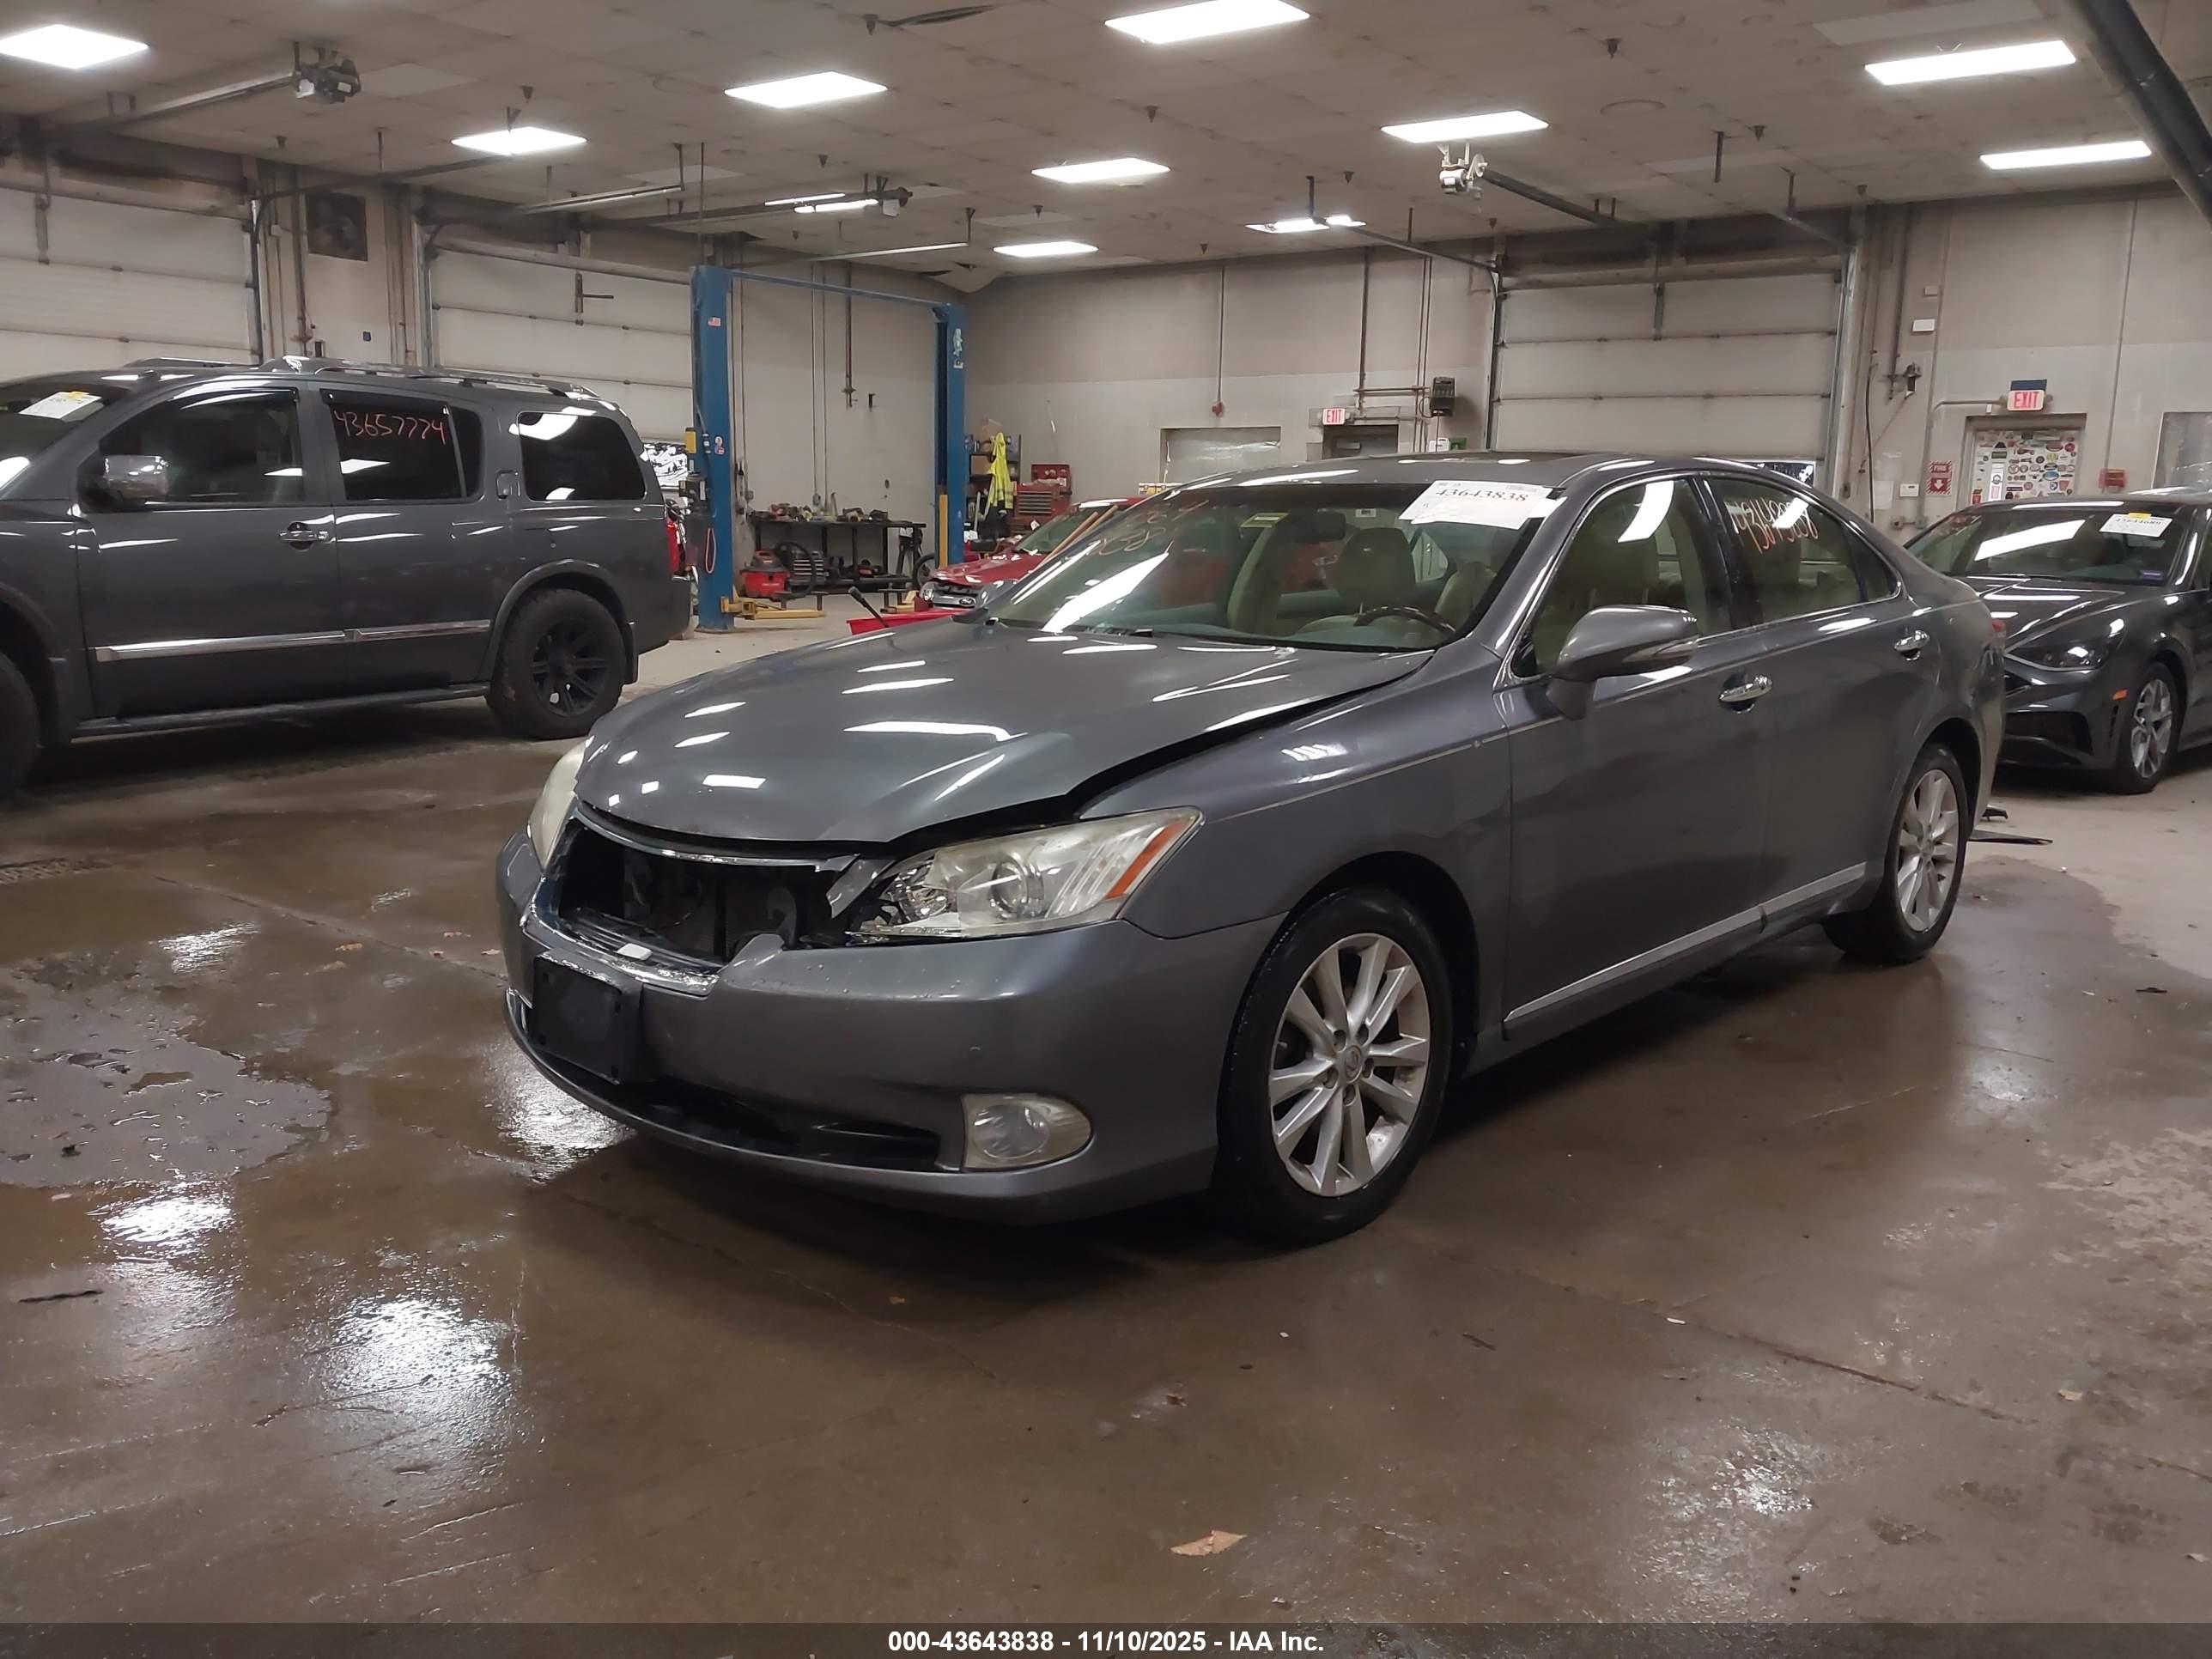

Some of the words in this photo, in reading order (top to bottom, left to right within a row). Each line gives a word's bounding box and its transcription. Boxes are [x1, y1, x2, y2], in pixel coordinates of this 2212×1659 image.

[2013, 391, 2040, 409] EXIT
[1326, 409, 1343, 423] EXIT
[1435, 488, 1529, 502] 43643838
